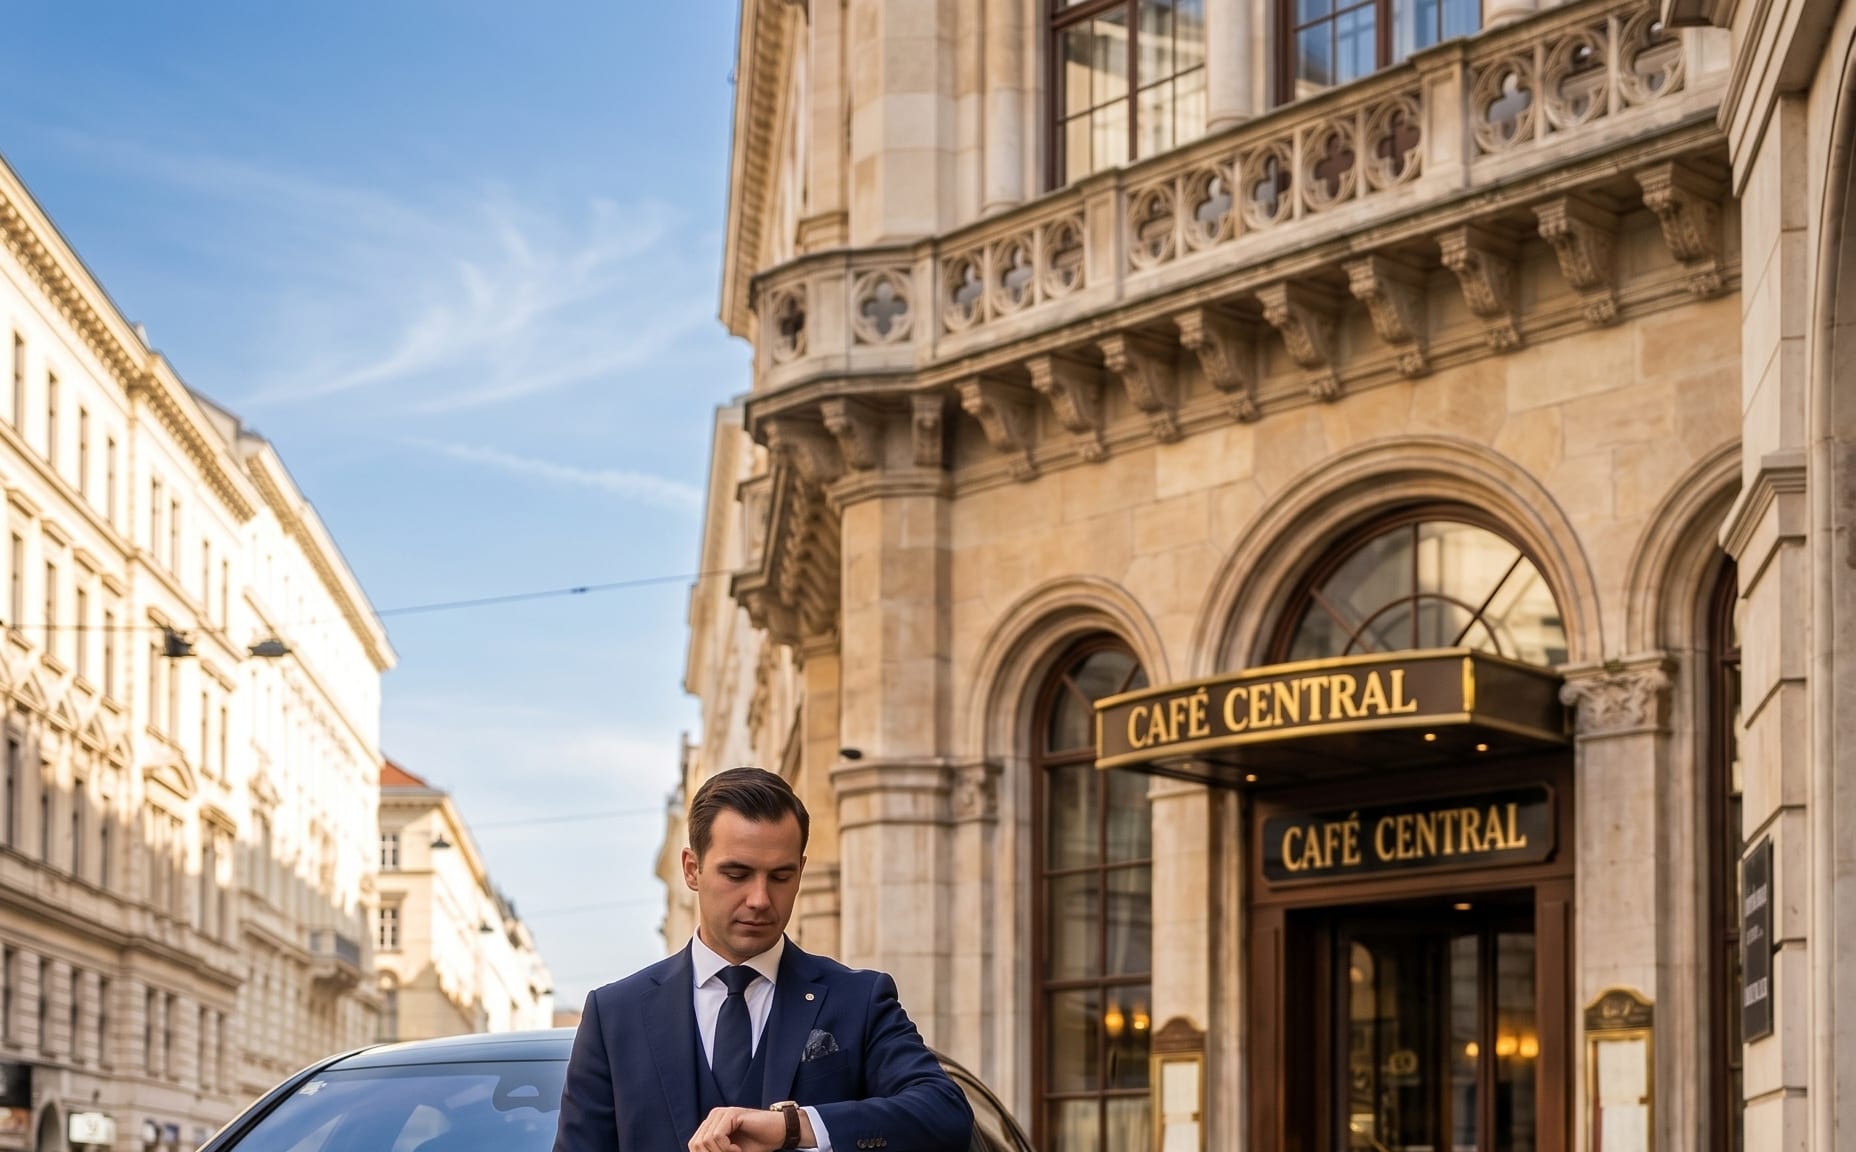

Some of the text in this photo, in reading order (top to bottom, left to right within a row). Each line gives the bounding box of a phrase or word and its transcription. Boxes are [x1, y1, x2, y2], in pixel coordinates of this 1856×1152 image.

[1127, 668, 1418, 749] CAFÉ CENTRAL
[1281, 803, 1528, 872] CAFÉ CENTRAL
